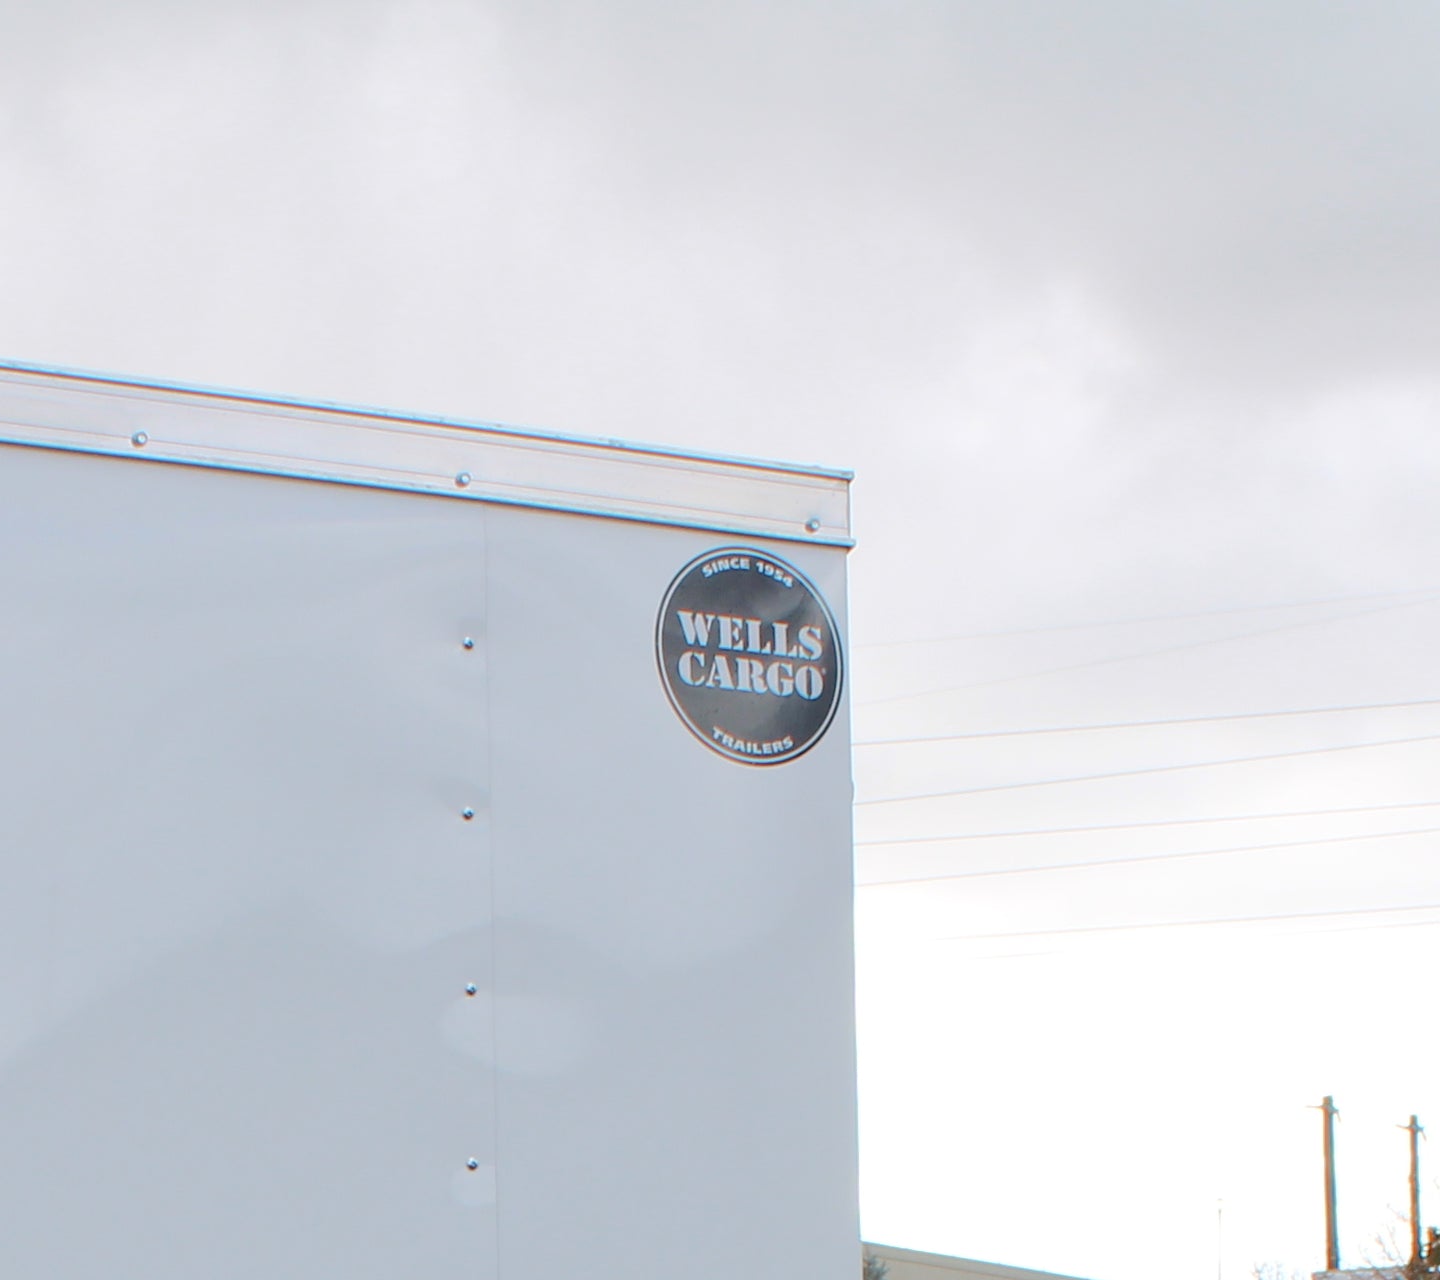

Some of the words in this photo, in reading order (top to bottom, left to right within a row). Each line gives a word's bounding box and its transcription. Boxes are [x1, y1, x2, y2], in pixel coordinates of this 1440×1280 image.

[701, 557, 750, 578] SINCE
[755, 560, 793, 588] 1954
[676, 609, 823, 661] WELLS
[677, 651, 824, 701] CARGO
[711, 726, 794, 755] TRAILERS
